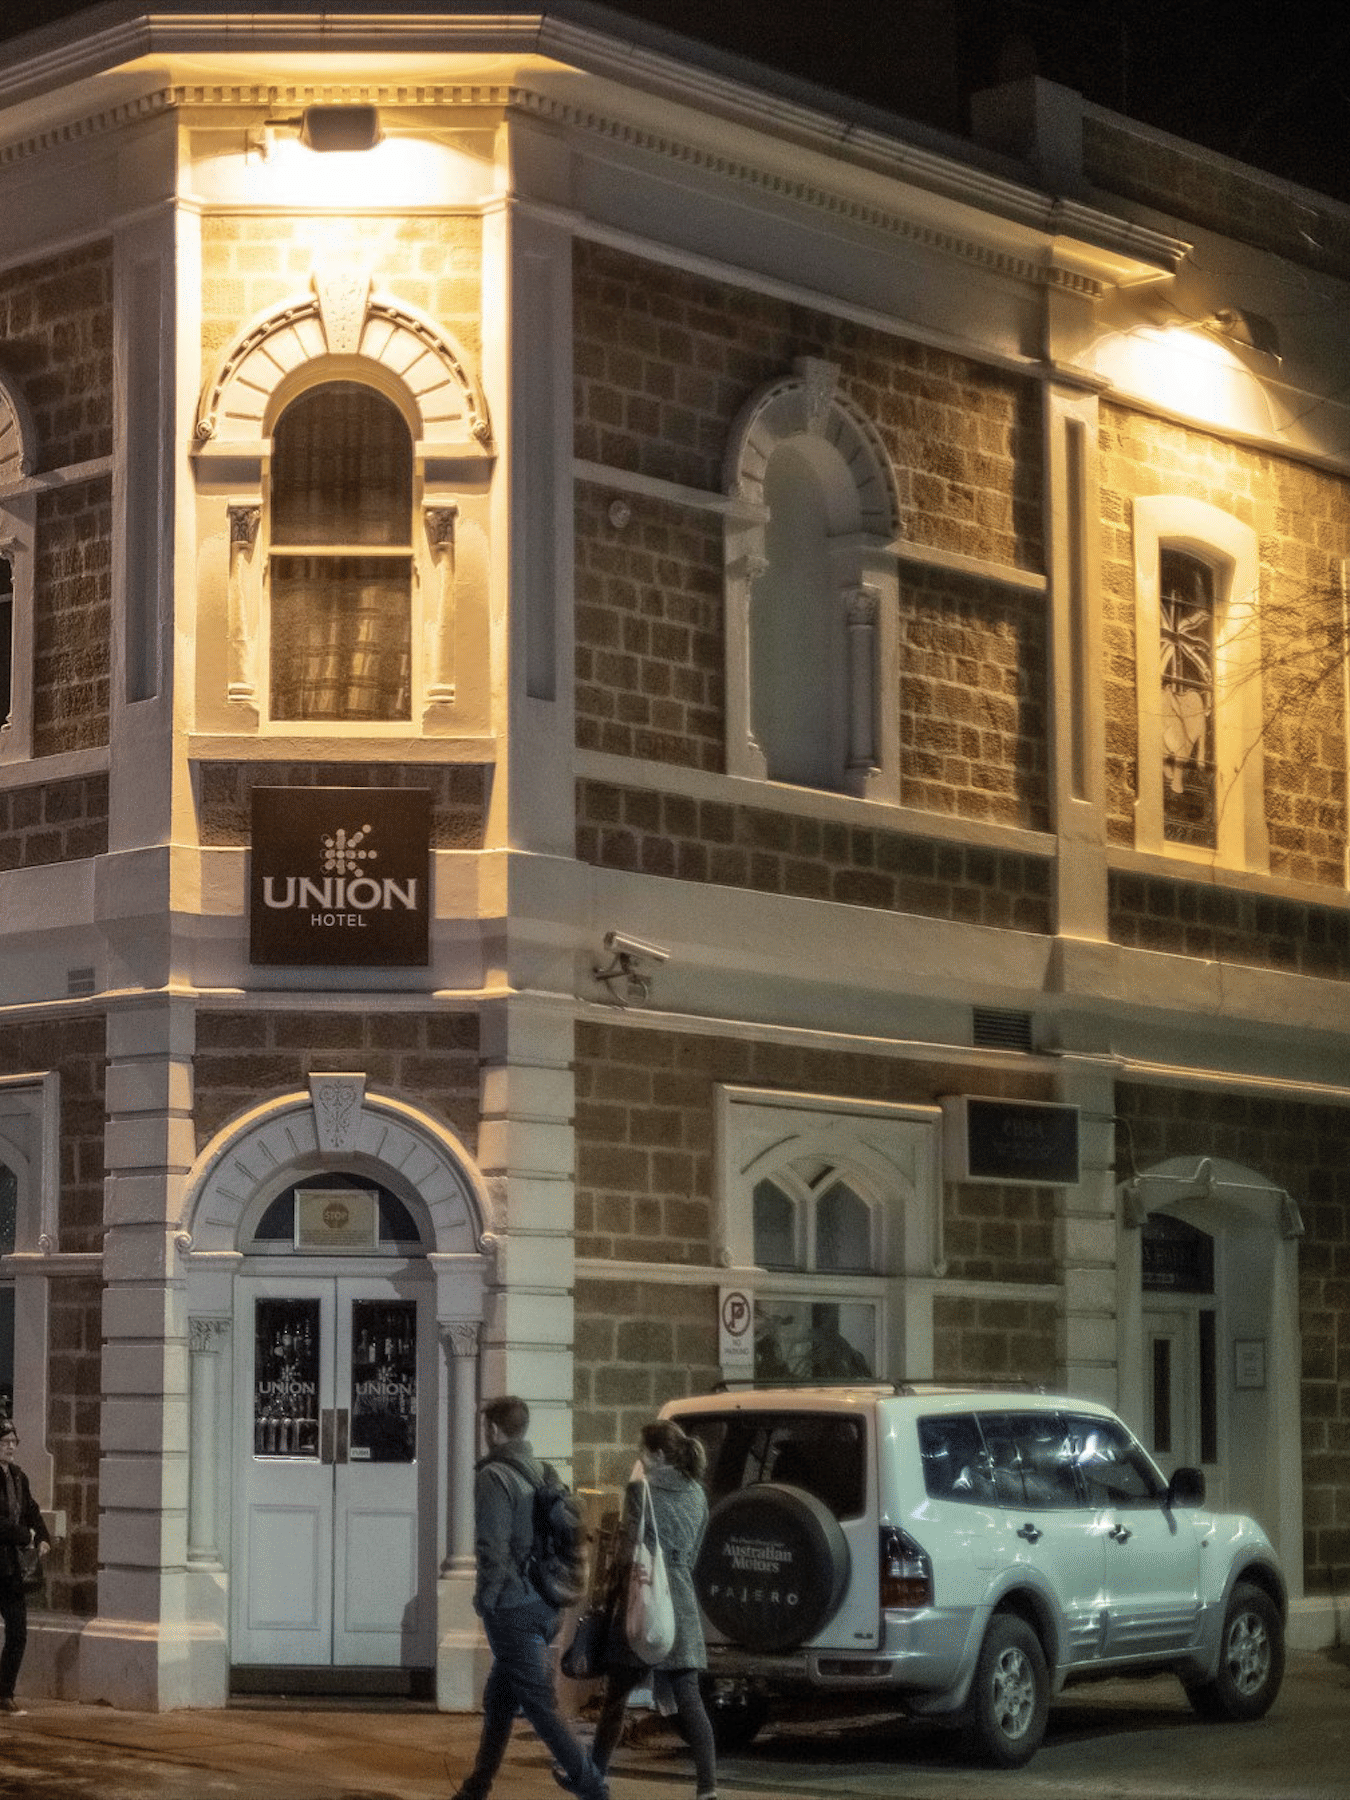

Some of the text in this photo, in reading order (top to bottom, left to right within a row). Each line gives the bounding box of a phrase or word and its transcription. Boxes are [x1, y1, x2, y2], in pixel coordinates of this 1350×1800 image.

[262, 876, 418, 910] UNION
[310, 913, 367, 927] HOTEL
[258, 1381, 316, 1395] UNION
[355, 1382, 412, 1396] UNION
[722, 1542, 793, 1562] Australian
[731, 1556, 780, 1574] Motors
[710, 1584, 799, 1606] PAJERO
